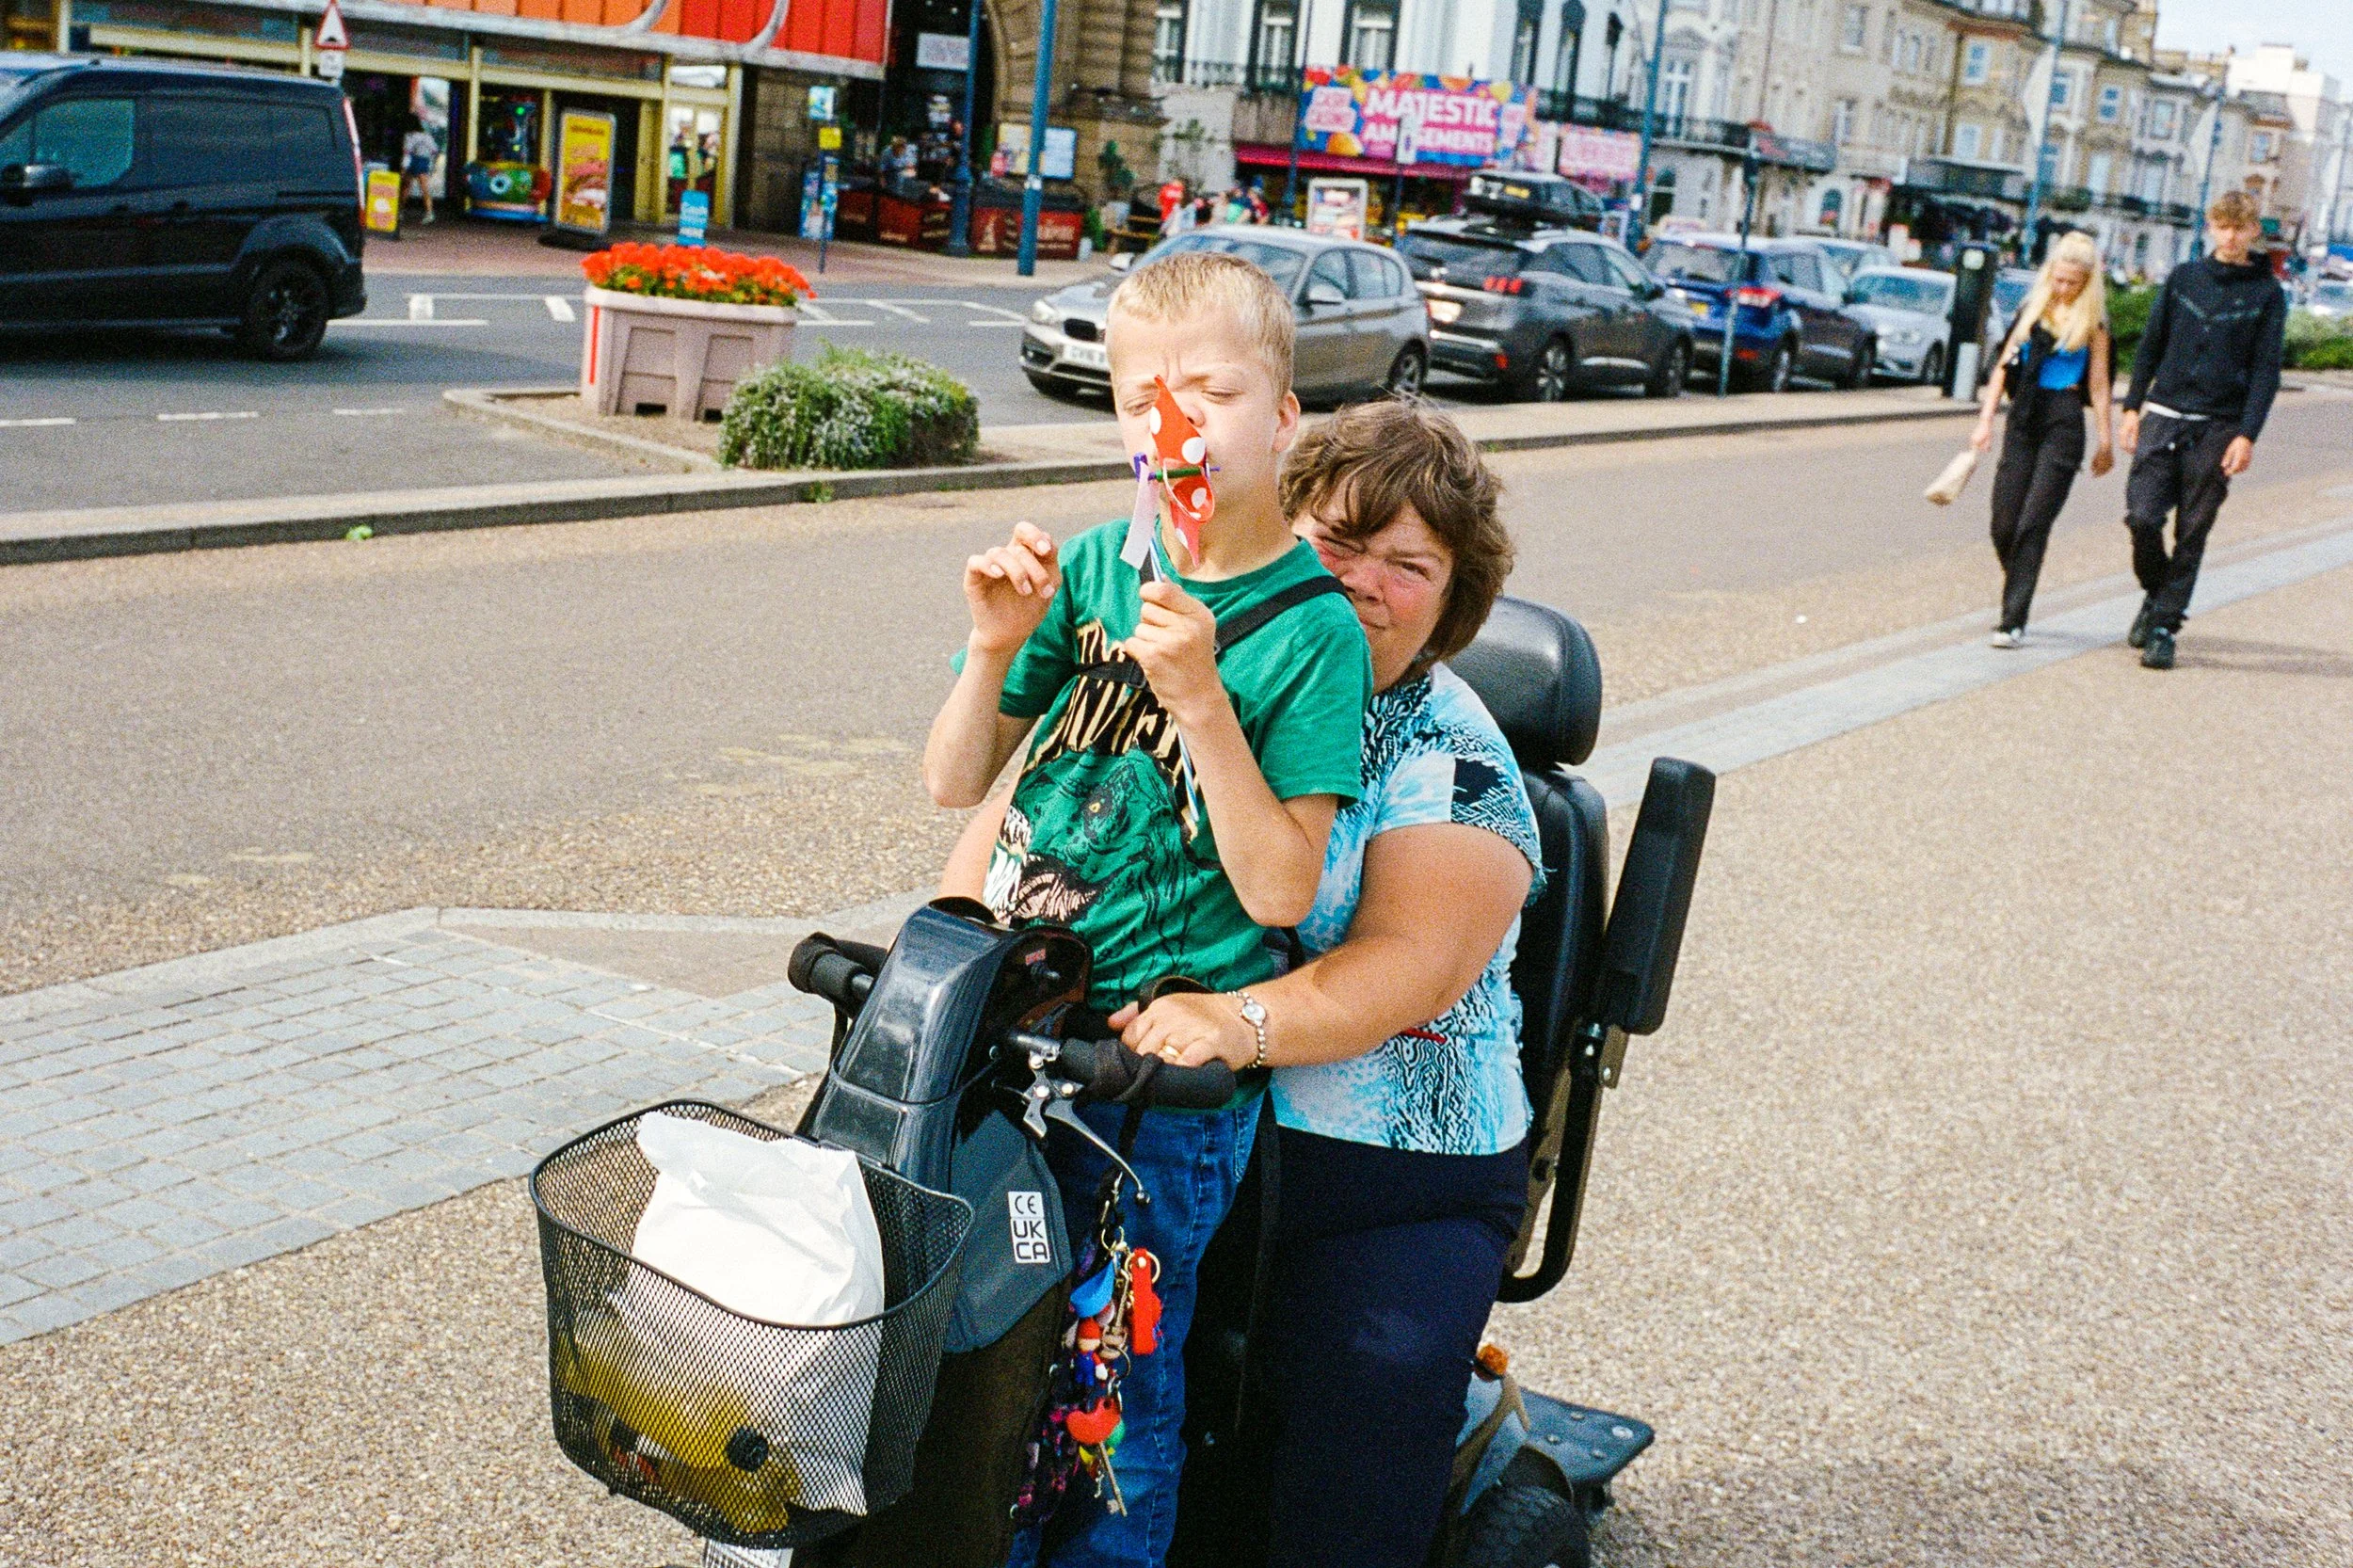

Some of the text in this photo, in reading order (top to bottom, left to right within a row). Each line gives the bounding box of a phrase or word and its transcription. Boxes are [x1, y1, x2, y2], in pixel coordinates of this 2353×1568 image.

[1364, 88, 1498, 128] MAJESTIC
[1363, 123, 1494, 154] AMSEMENTS
[1015, 1194, 1037, 1215] CE
[1013, 1220, 1044, 1240] UK
[1016, 1241, 1048, 1260] CA
